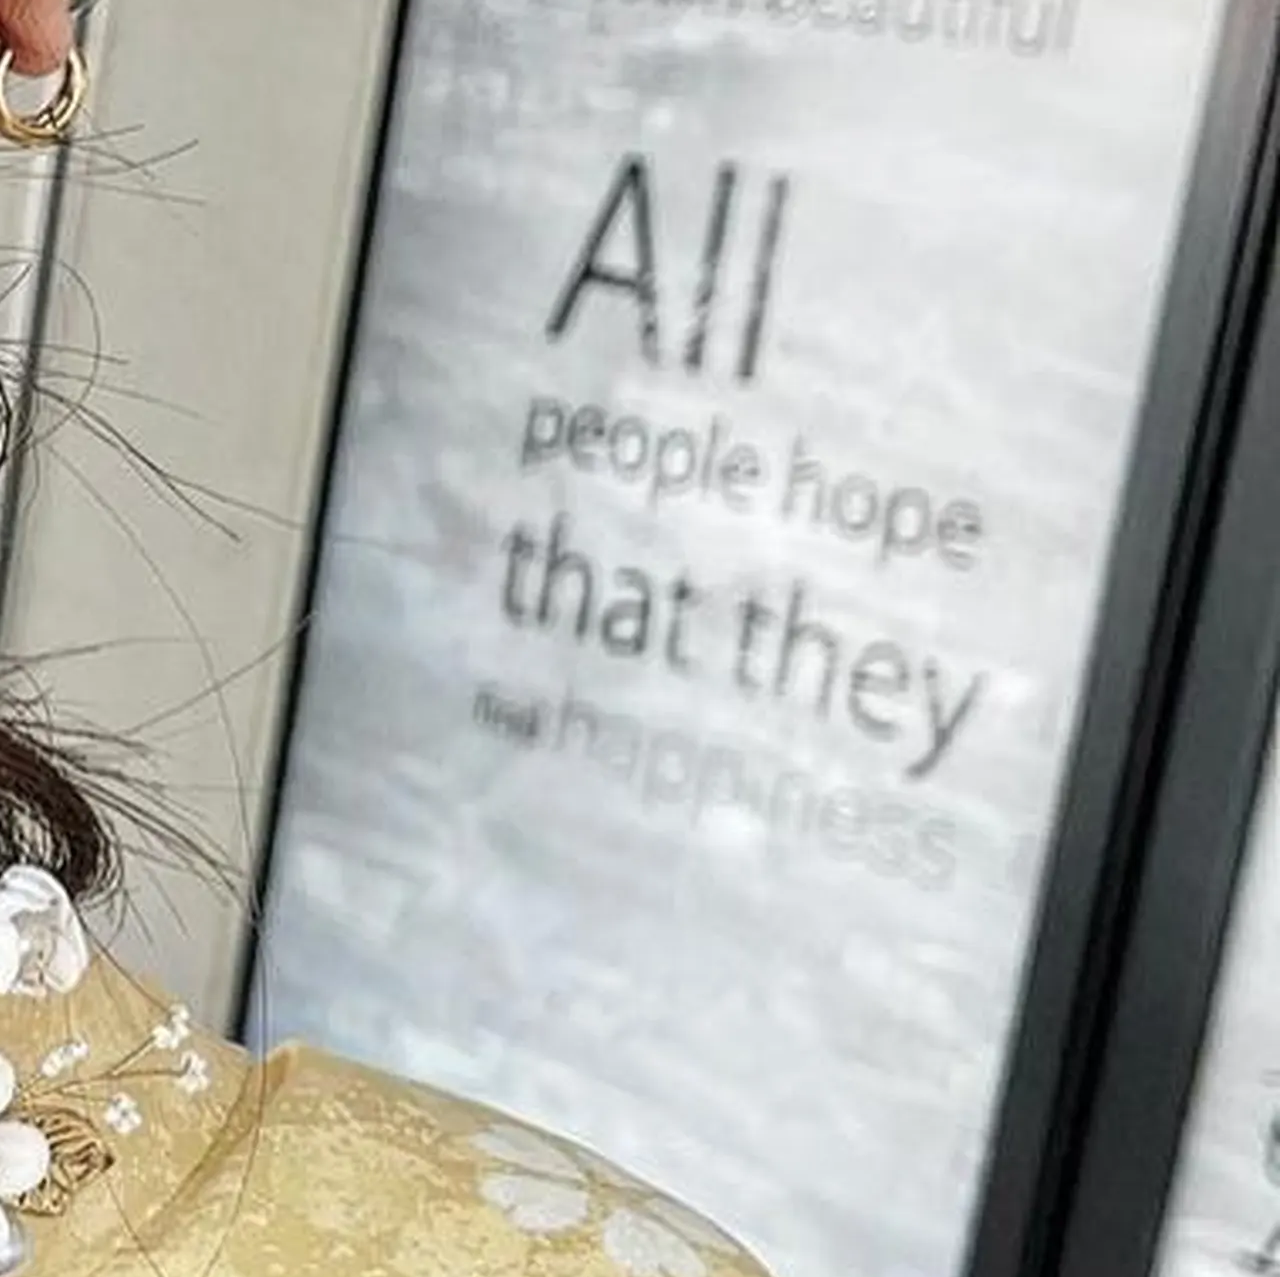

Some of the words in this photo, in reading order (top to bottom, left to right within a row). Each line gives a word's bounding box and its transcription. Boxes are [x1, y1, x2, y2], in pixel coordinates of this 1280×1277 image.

[543, 151, 791, 384] All
[520, 393, 765, 509] people
[781, 432, 986, 570] hope
[498, 512, 694, 674] that
[732, 579, 992, 778] they
